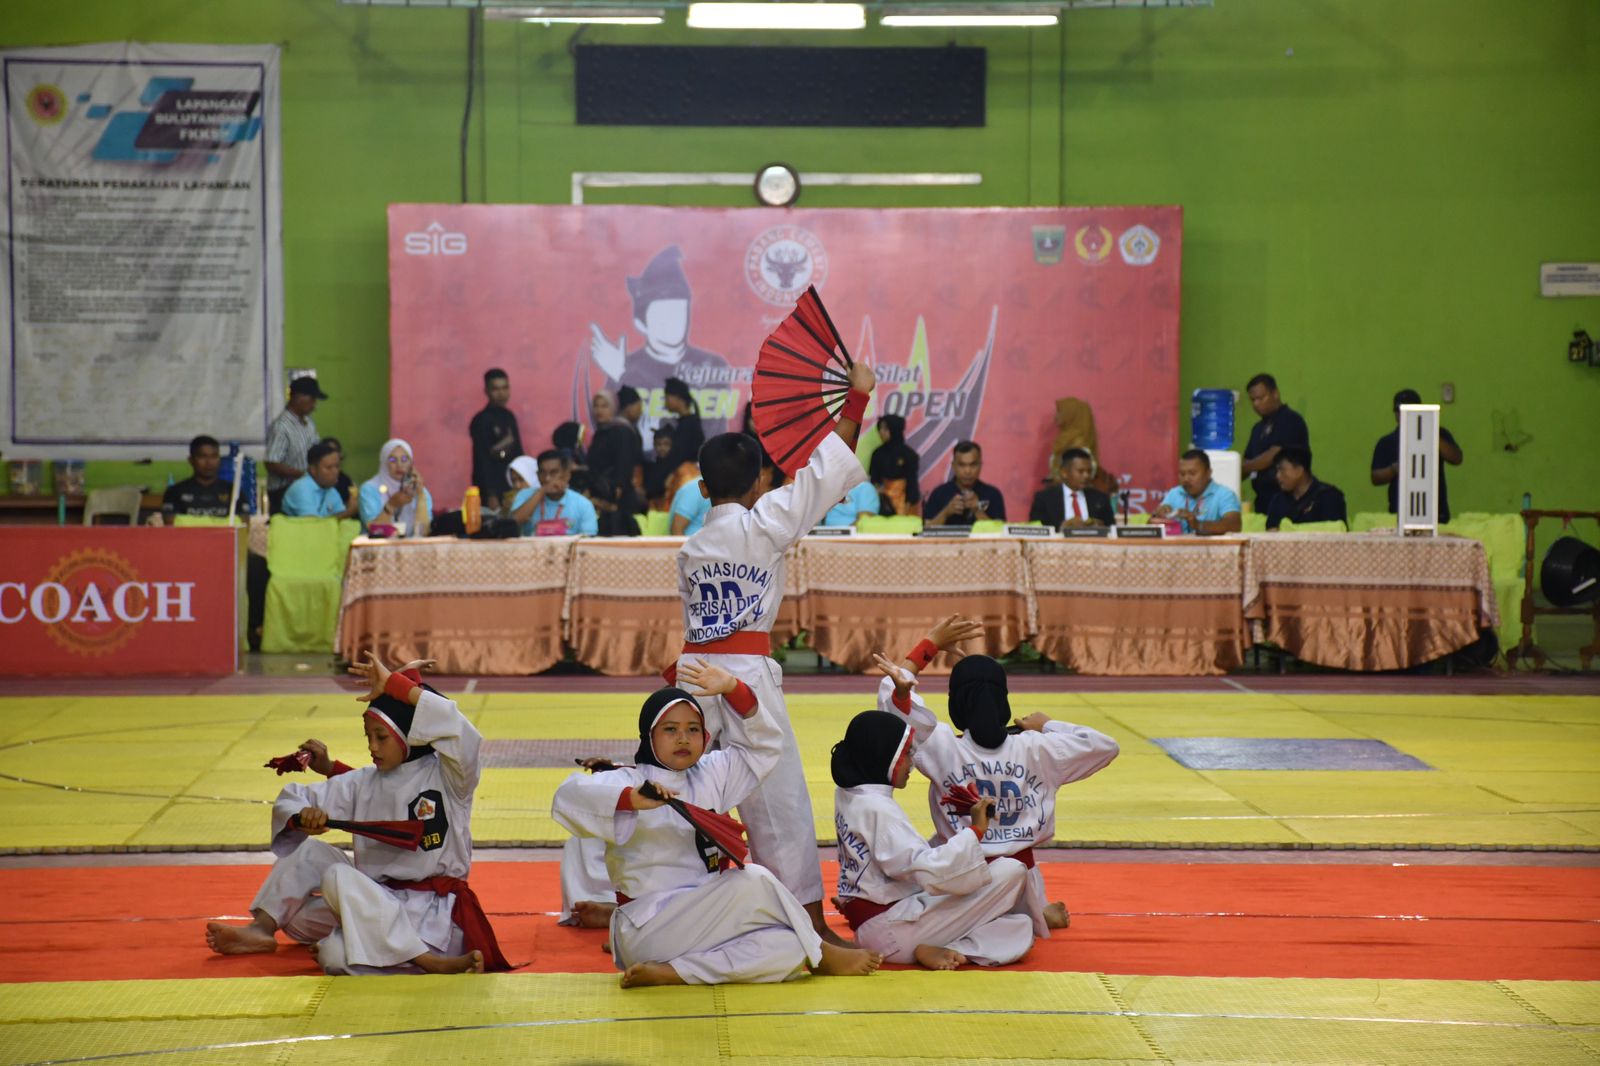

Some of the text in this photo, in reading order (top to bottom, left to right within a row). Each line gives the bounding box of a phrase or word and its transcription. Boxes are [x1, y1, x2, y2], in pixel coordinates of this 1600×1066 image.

[176, 98, 246, 110] LAPANGAN
[20, 178, 251, 191] PERATURAN PEMAKAIAN LAPANGAN
[875, 363, 921, 383] Silat
[883, 390, 967, 418] OPEN
[0, 582, 196, 623] COACH
[689, 619, 748, 641] INDONESIA
[943, 763, 977, 789] SILAT
